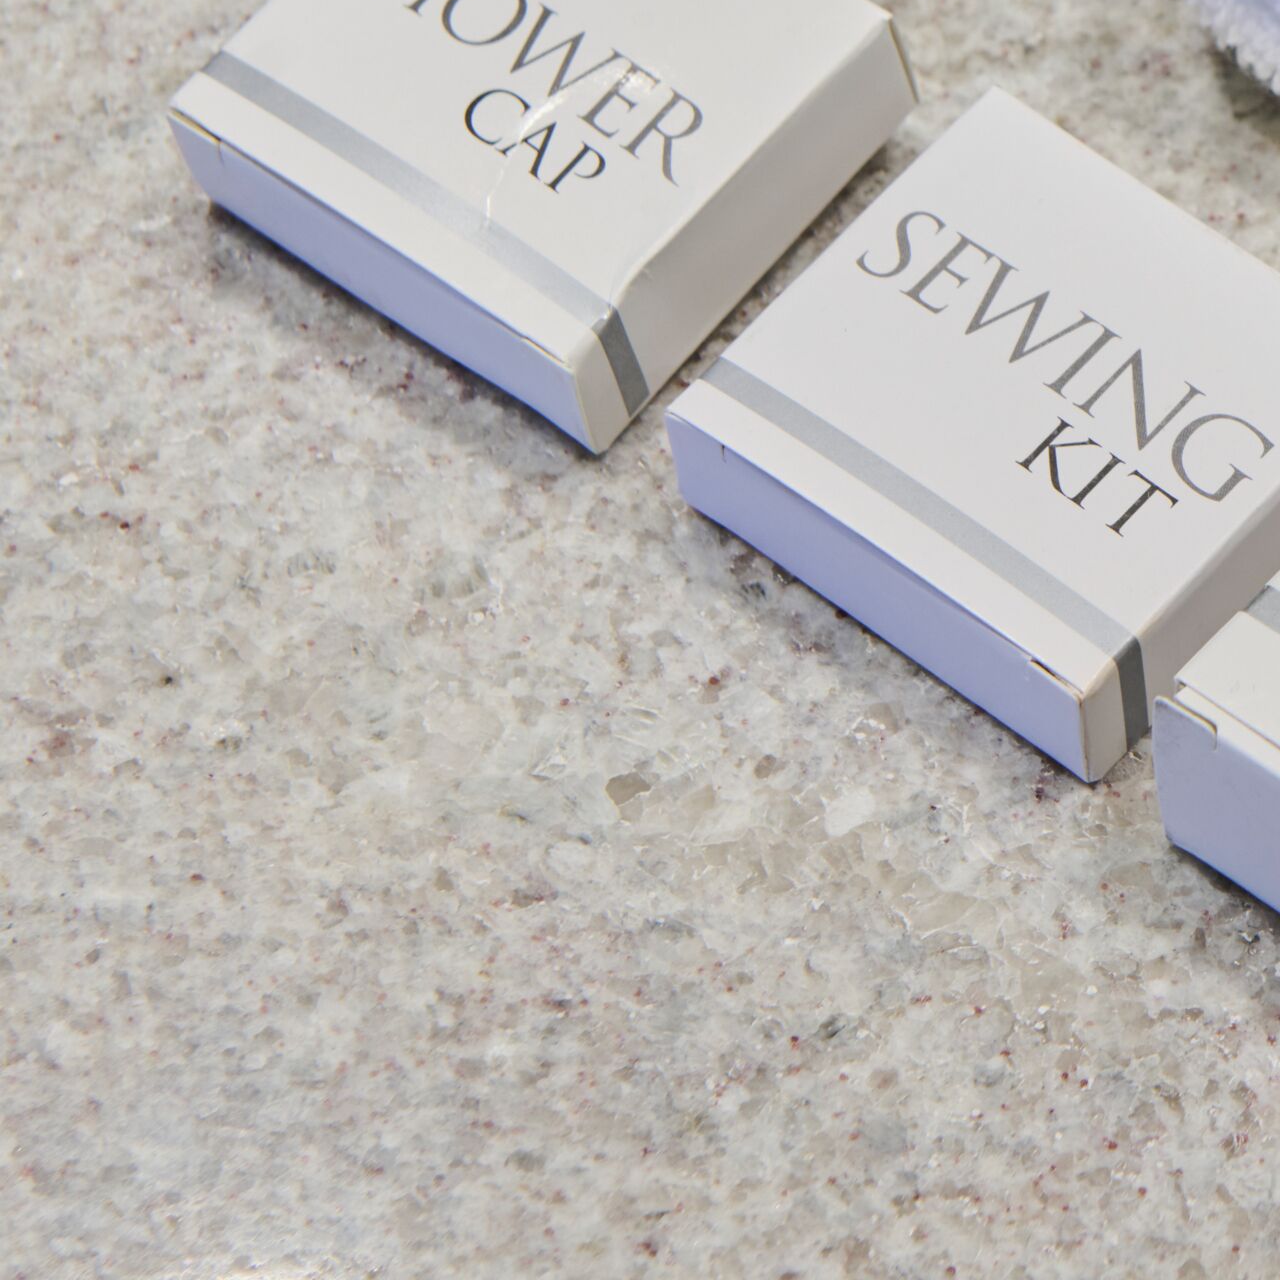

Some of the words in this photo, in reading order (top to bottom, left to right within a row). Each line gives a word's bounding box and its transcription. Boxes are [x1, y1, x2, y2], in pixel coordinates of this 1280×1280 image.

[463, 88, 607, 193] CAP
[854, 209, 1276, 506] SEWING
[1014, 417, 1178, 538] KIT
